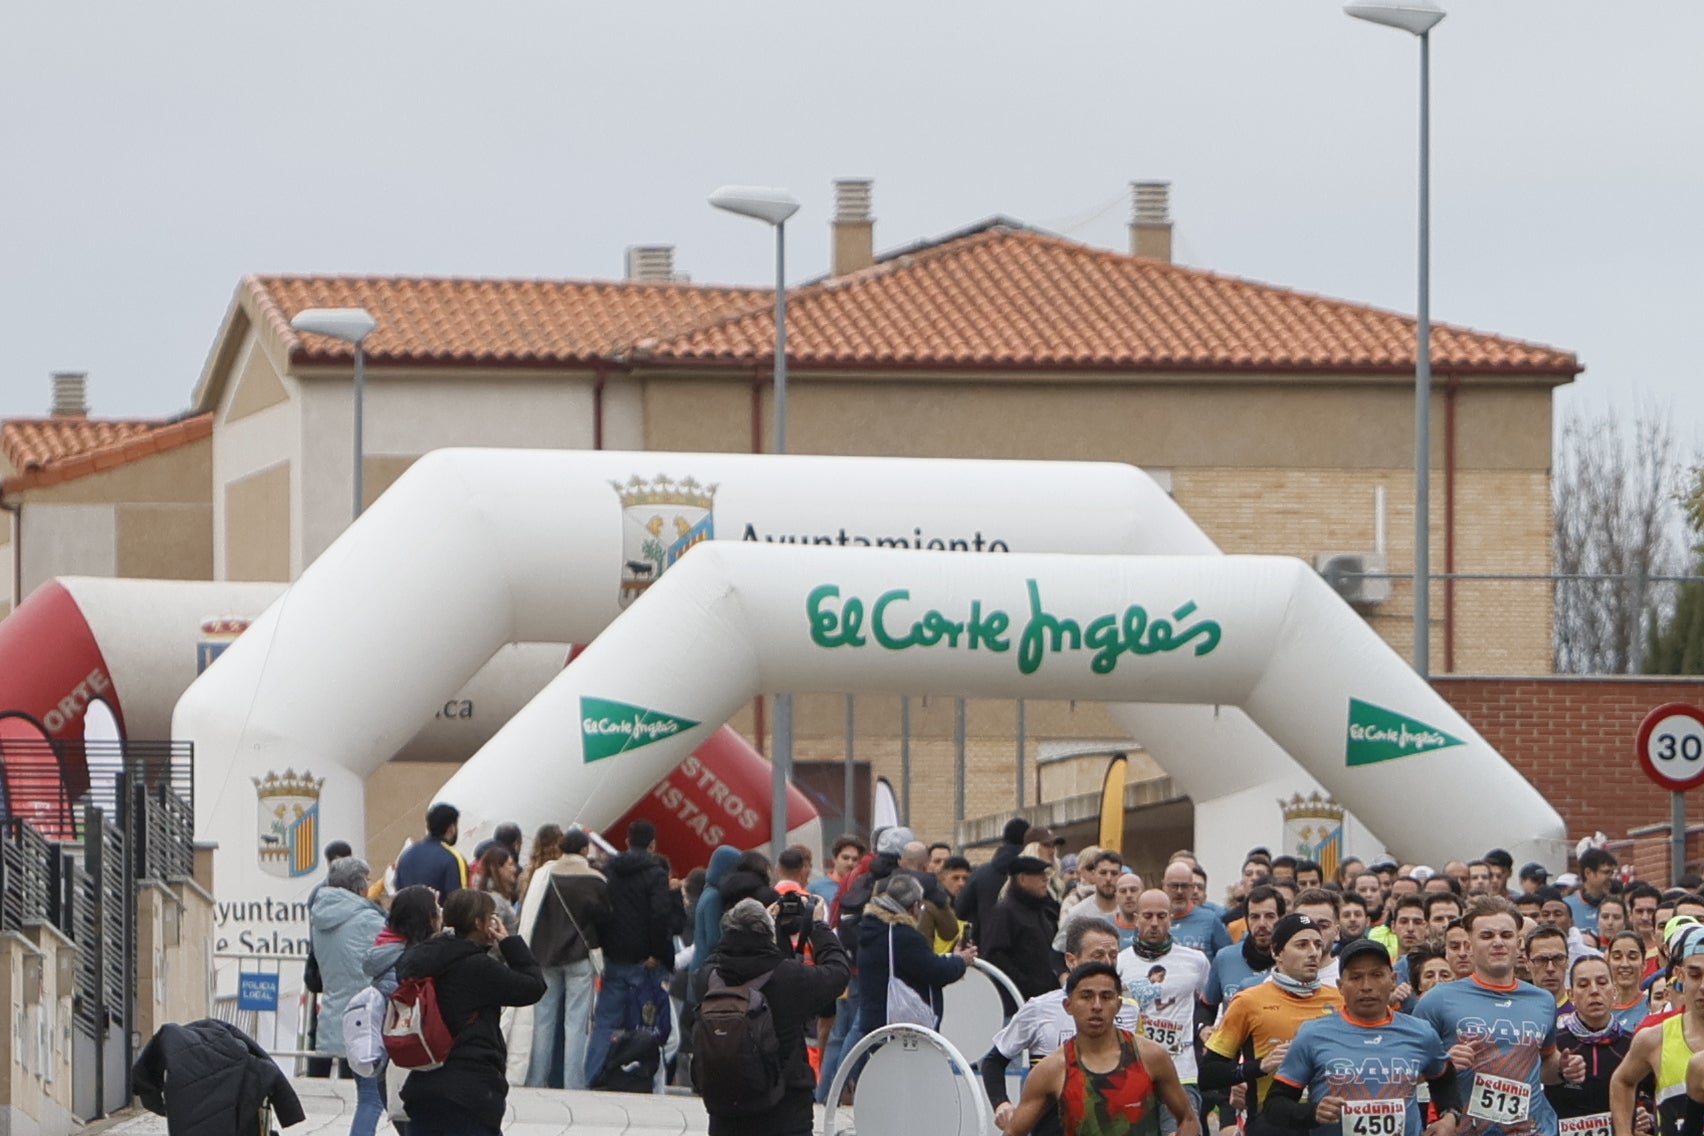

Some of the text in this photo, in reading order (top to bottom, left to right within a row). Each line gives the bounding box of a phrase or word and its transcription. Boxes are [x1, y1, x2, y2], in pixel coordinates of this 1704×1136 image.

[806, 578, 1221, 674] El Corte Inglés
[583, 714, 679, 739] El Corte Inglés
[1350, 723, 1445, 749] El Corte Inglés
[1657, 732, 1703, 762] 30
[1146, 1027, 1176, 1045] 335
[1456, 1016, 1547, 1048] SAN
[1325, 1057, 1420, 1086] SAN
[1474, 1076, 1530, 1097] bedunia
[1344, 1103, 1404, 1115] bedunia
[1480, 1090, 1520, 1115] 513
[1353, 1115, 1396, 1136] 450
